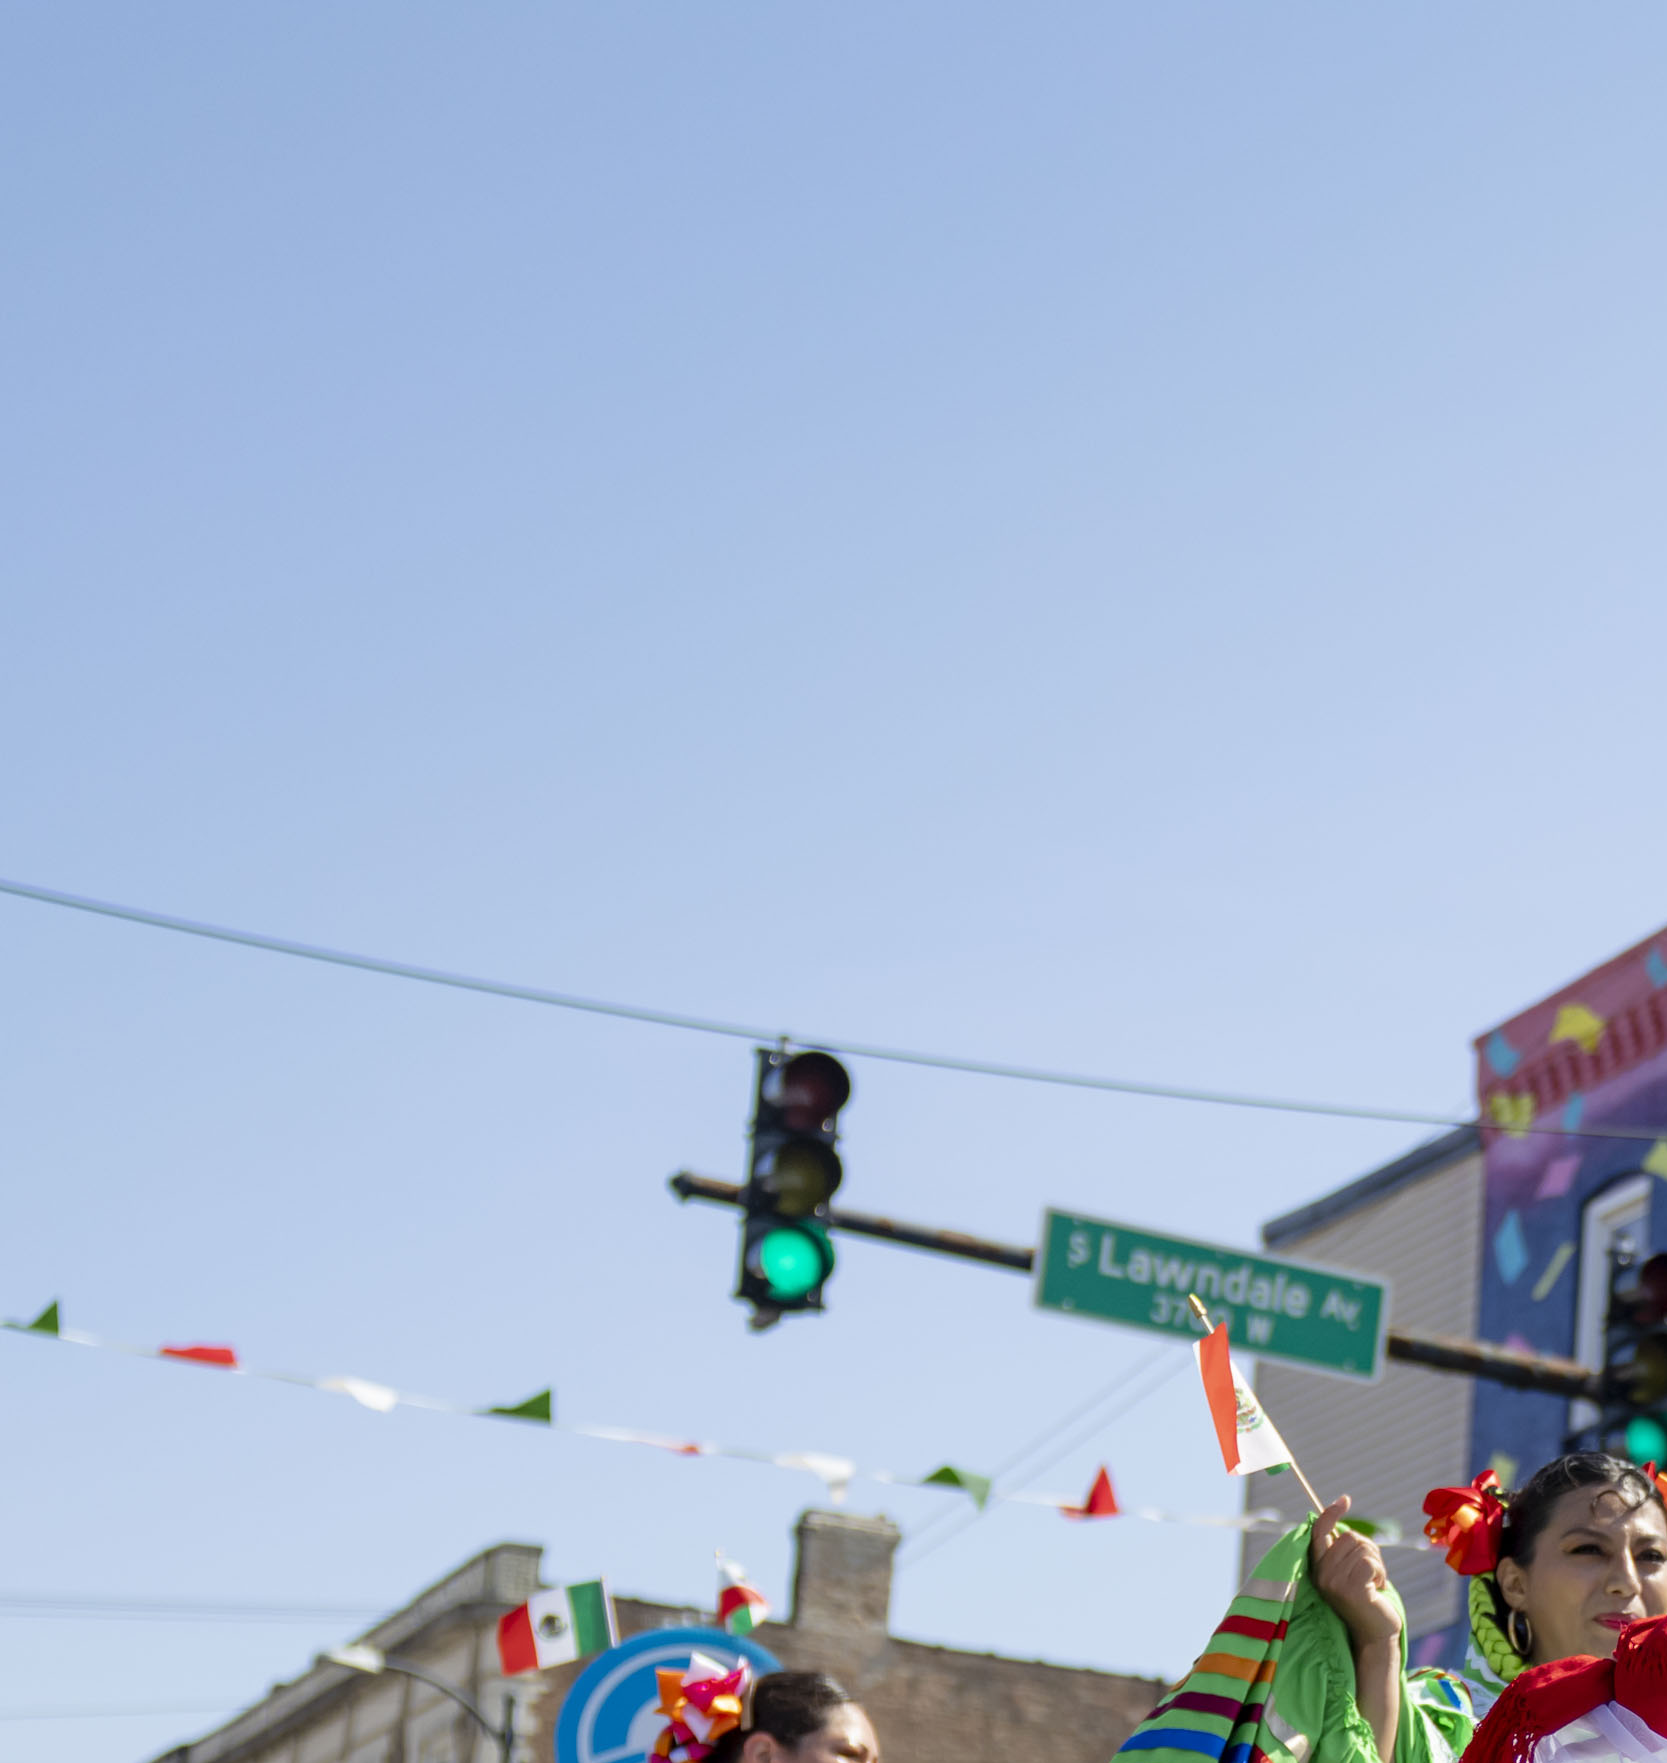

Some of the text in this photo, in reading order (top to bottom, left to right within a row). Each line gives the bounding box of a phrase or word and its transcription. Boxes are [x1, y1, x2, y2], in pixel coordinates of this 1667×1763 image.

[1067, 1231, 1089, 1265] S
[1099, 1233, 1310, 1318] Lawndale
[1246, 1314, 1275, 1344] W
